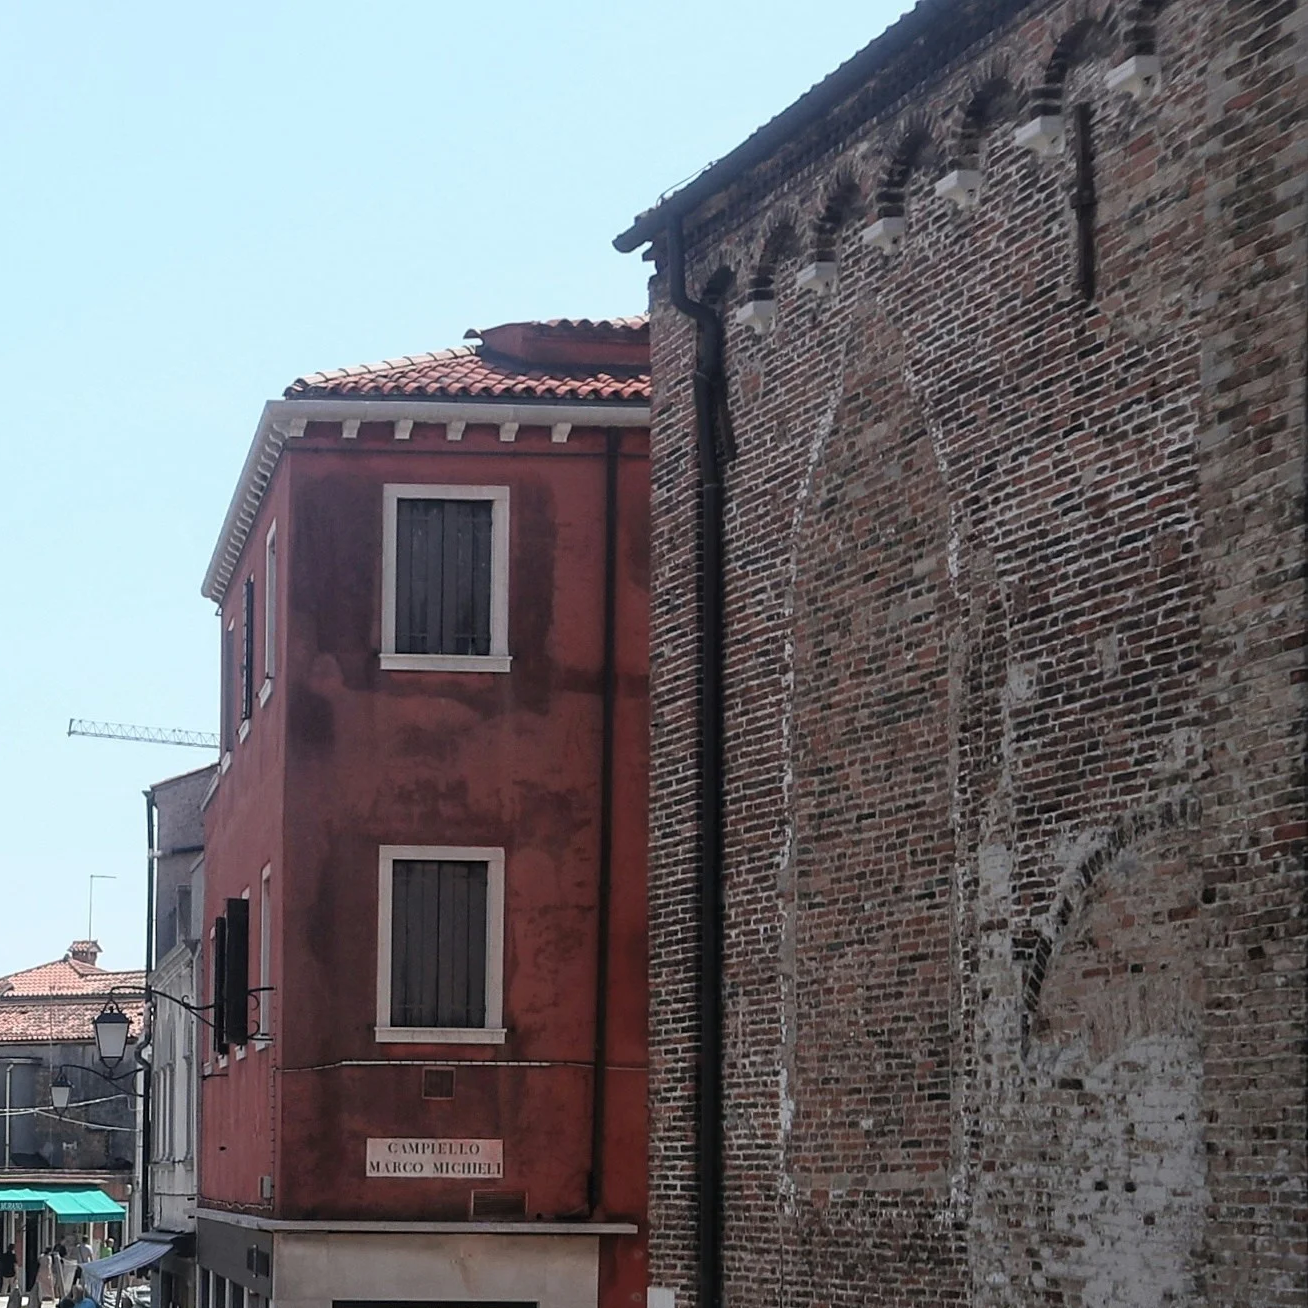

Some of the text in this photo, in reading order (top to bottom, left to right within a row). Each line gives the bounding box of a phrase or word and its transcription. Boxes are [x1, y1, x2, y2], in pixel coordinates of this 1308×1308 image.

[387, 1142, 481, 1155] CAMPIELLO
[369, 1161, 501, 1175] MARCO MICHIELI
